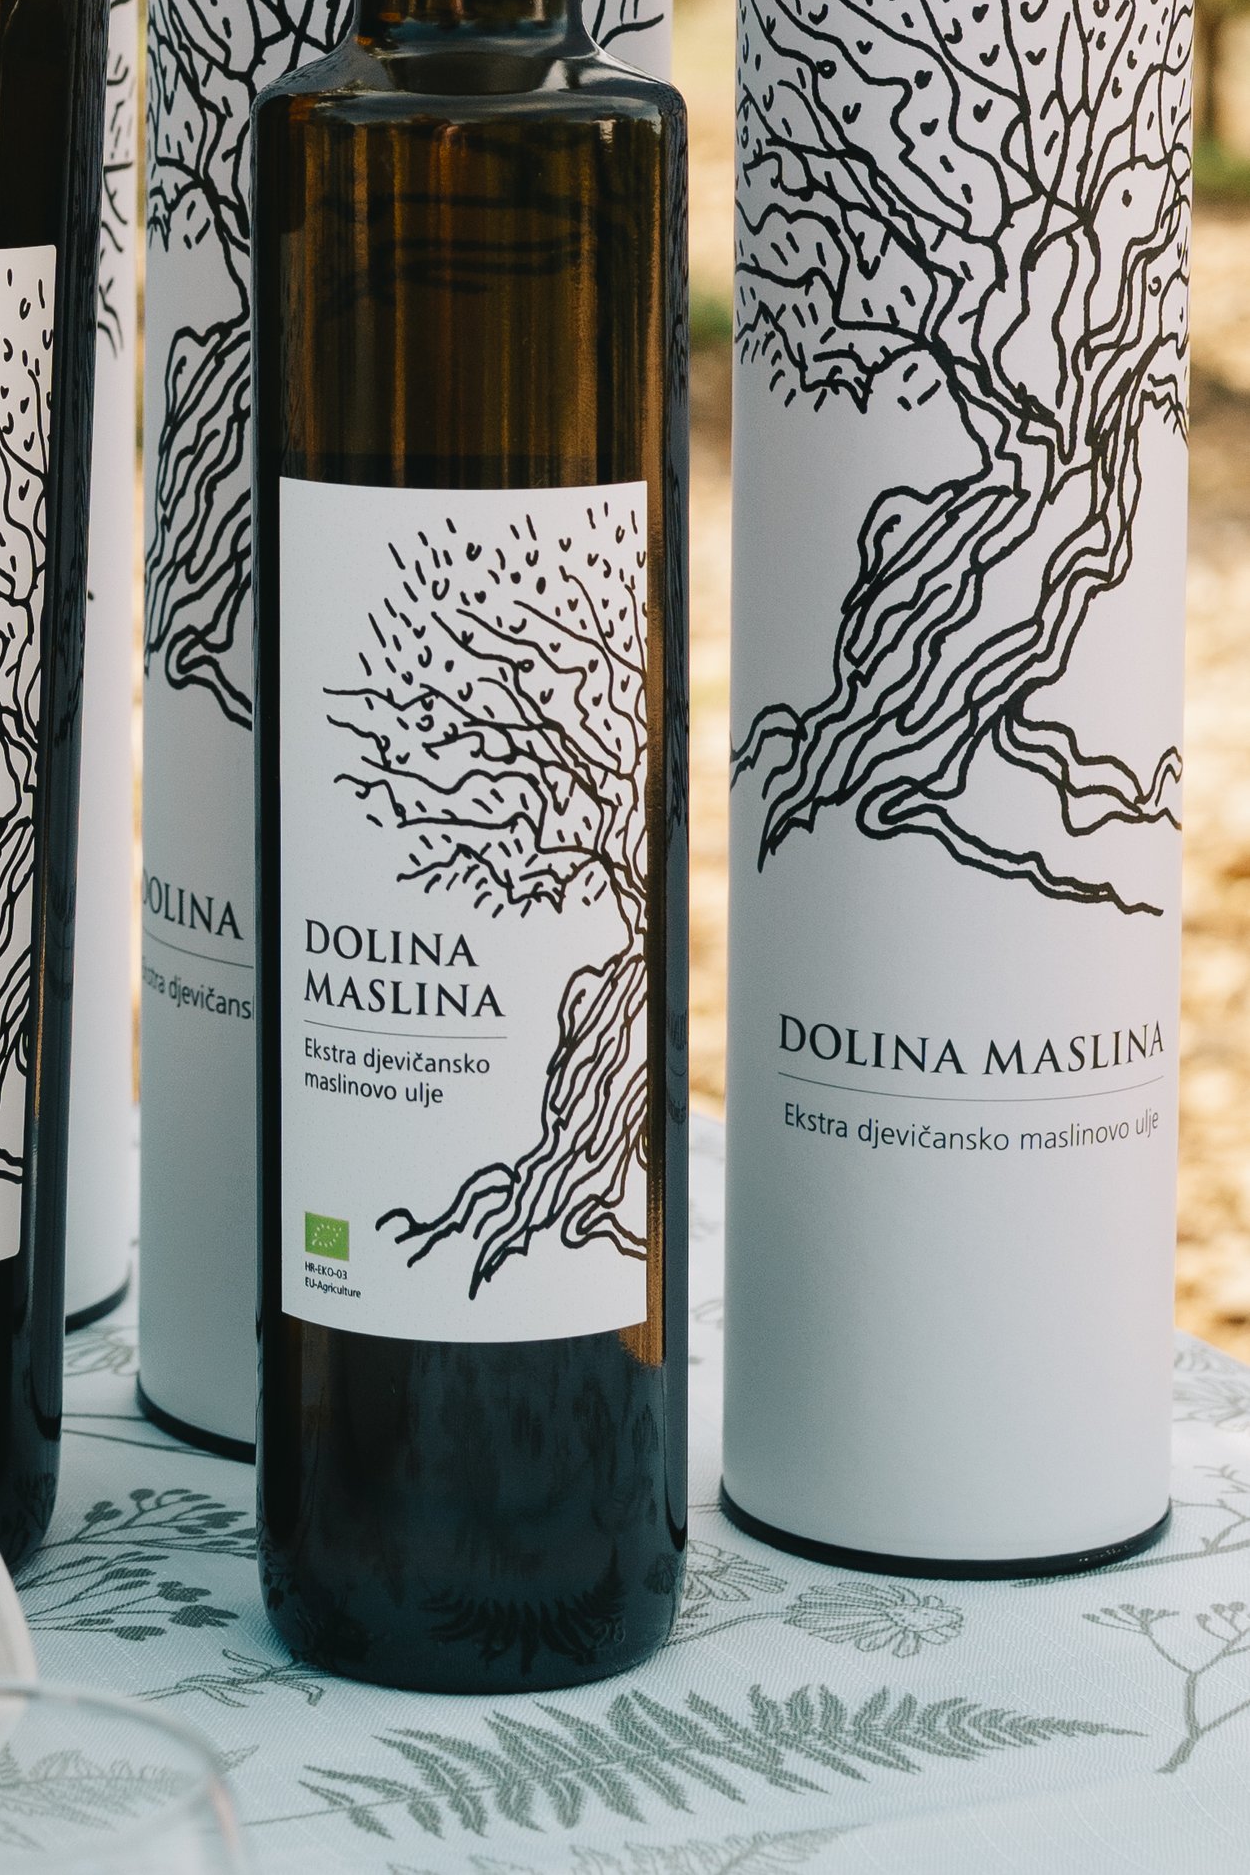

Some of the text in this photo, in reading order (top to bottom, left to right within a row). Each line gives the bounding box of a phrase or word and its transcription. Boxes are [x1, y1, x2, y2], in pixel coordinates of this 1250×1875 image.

[304, 918, 480, 967] DOLINA
[168, 974, 254, 1021] djevičans
[304, 968, 506, 1018] MASLINA
[305, 1037, 490, 1074] Ekstra djevičansko
[779, 1013, 1164, 1075] DOLINA MASLINA
[305, 1072, 444, 1108] maslinovo ulje
[785, 1102, 1159, 1151] Ekstra djevičansko maslinovo ulje
[304, 1261, 348, 1280] HR-EKO-03
[304, 1276, 362, 1298] EU-Agriculture
